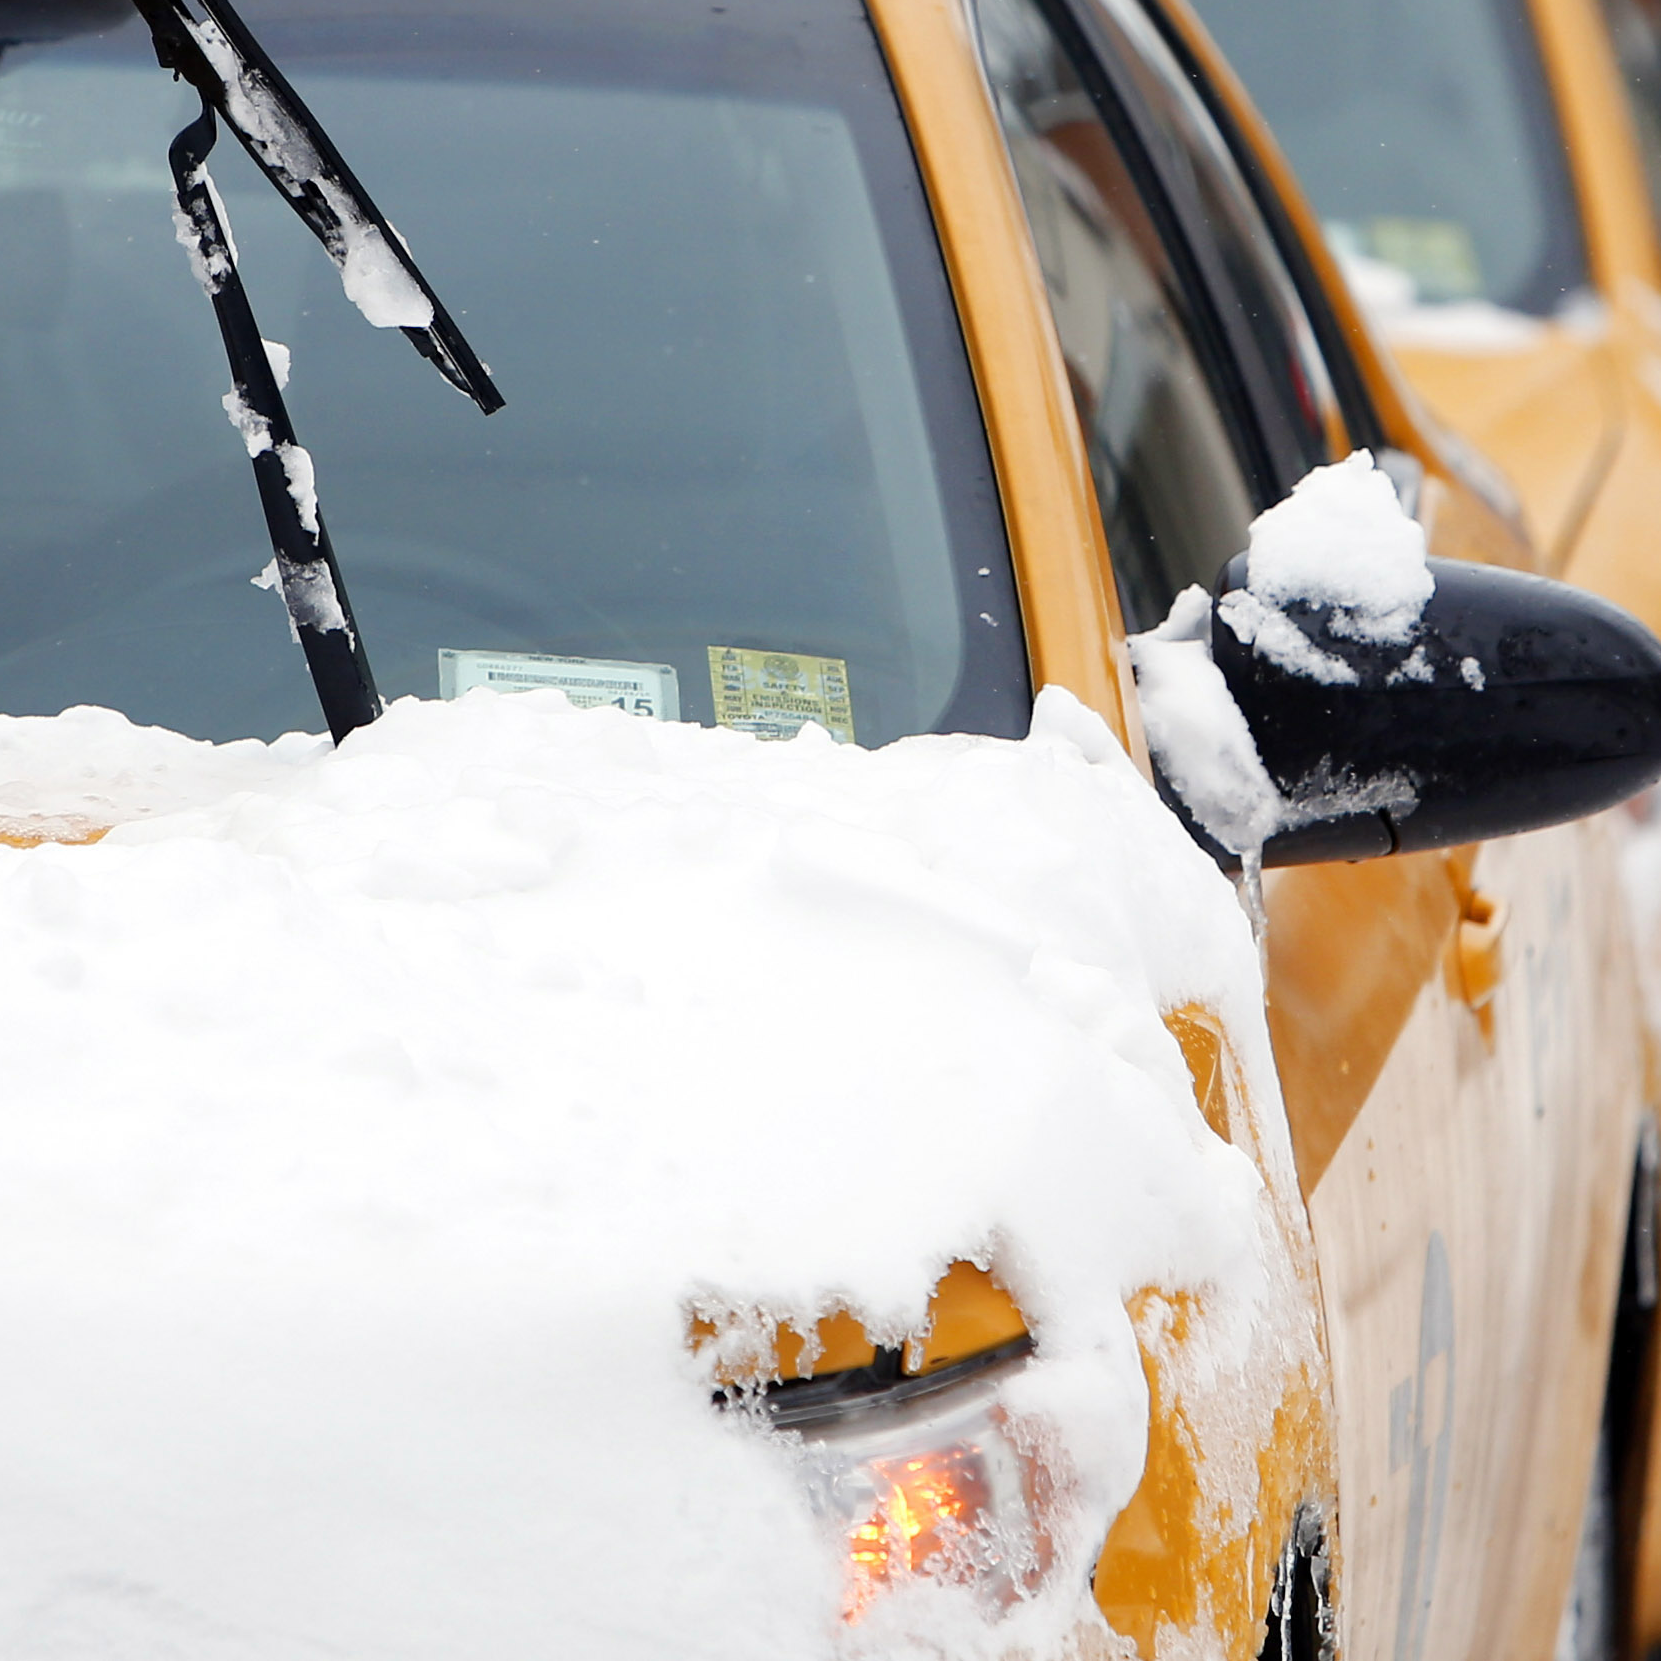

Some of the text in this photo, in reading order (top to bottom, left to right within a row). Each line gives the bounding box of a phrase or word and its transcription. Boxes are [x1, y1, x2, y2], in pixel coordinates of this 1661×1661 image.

[762, 681, 806, 693] SAFETY
[609, 695, 654, 718] 15
[751, 693, 819, 707] EMISSIONS
[750, 701, 822, 714] INSPECTION
[721, 713, 765, 721] TOYOTA
